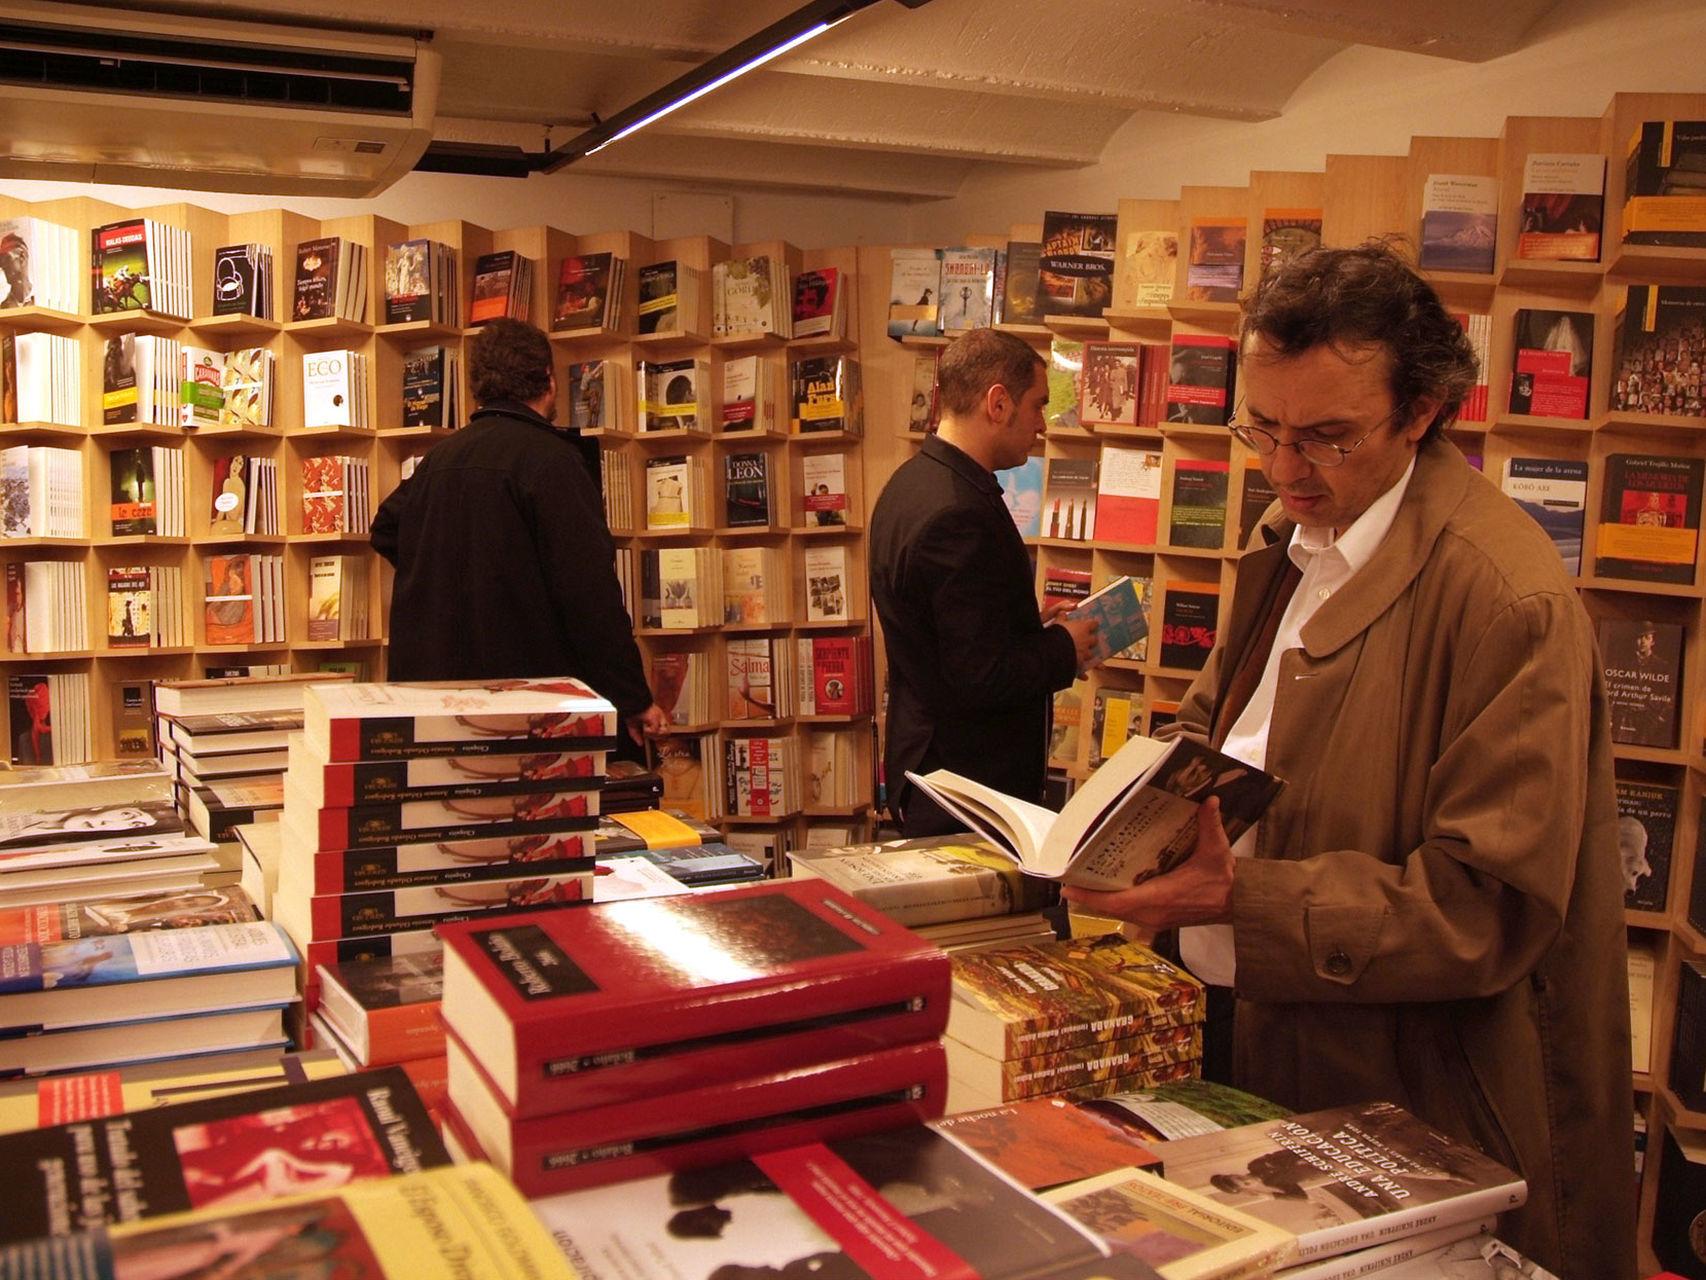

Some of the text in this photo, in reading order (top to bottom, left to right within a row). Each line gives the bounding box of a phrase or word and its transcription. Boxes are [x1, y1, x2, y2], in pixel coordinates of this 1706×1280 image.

[1050, 260, 1083, 270] WARNER
[306, 359, 342, 377] ECO
[808, 377, 836, 392] Alan
[732, 460, 760, 468] DONNA
[1514, 464, 1523, 472] La
[1545, 466, 1554, 474] de
[1555, 466, 1562, 474] la
[727, 466, 764, 480] LEON
[730, 656, 771, 677] Salma
[1604, 668, 1670, 683] OSCAR WILDE
[1613, 682, 1640, 691] crimen
[1620, 690, 1647, 700] Arthur
[1090, 1015, 1134, 1033] GRANADA
[1086, 1053, 1130, 1072] GRANADA
[957, 1111, 996, 1125] noche
[1281, 1122, 1411, 1200] UNA EDUCACIÓN
[1332, 1131, 1409, 1176] POLÍTICA
[1267, 1131, 1379, 1198] ANDRÉ SCHIFFRIN
[1378, 1221, 1414, 1237] SCHIFFRIN
[1415, 1215, 1438, 1228] ANDRÉ
[1359, 1256, 1392, 1273] SCHIFFRIN
[1393, 1250, 1414, 1264] ANDRÉ
